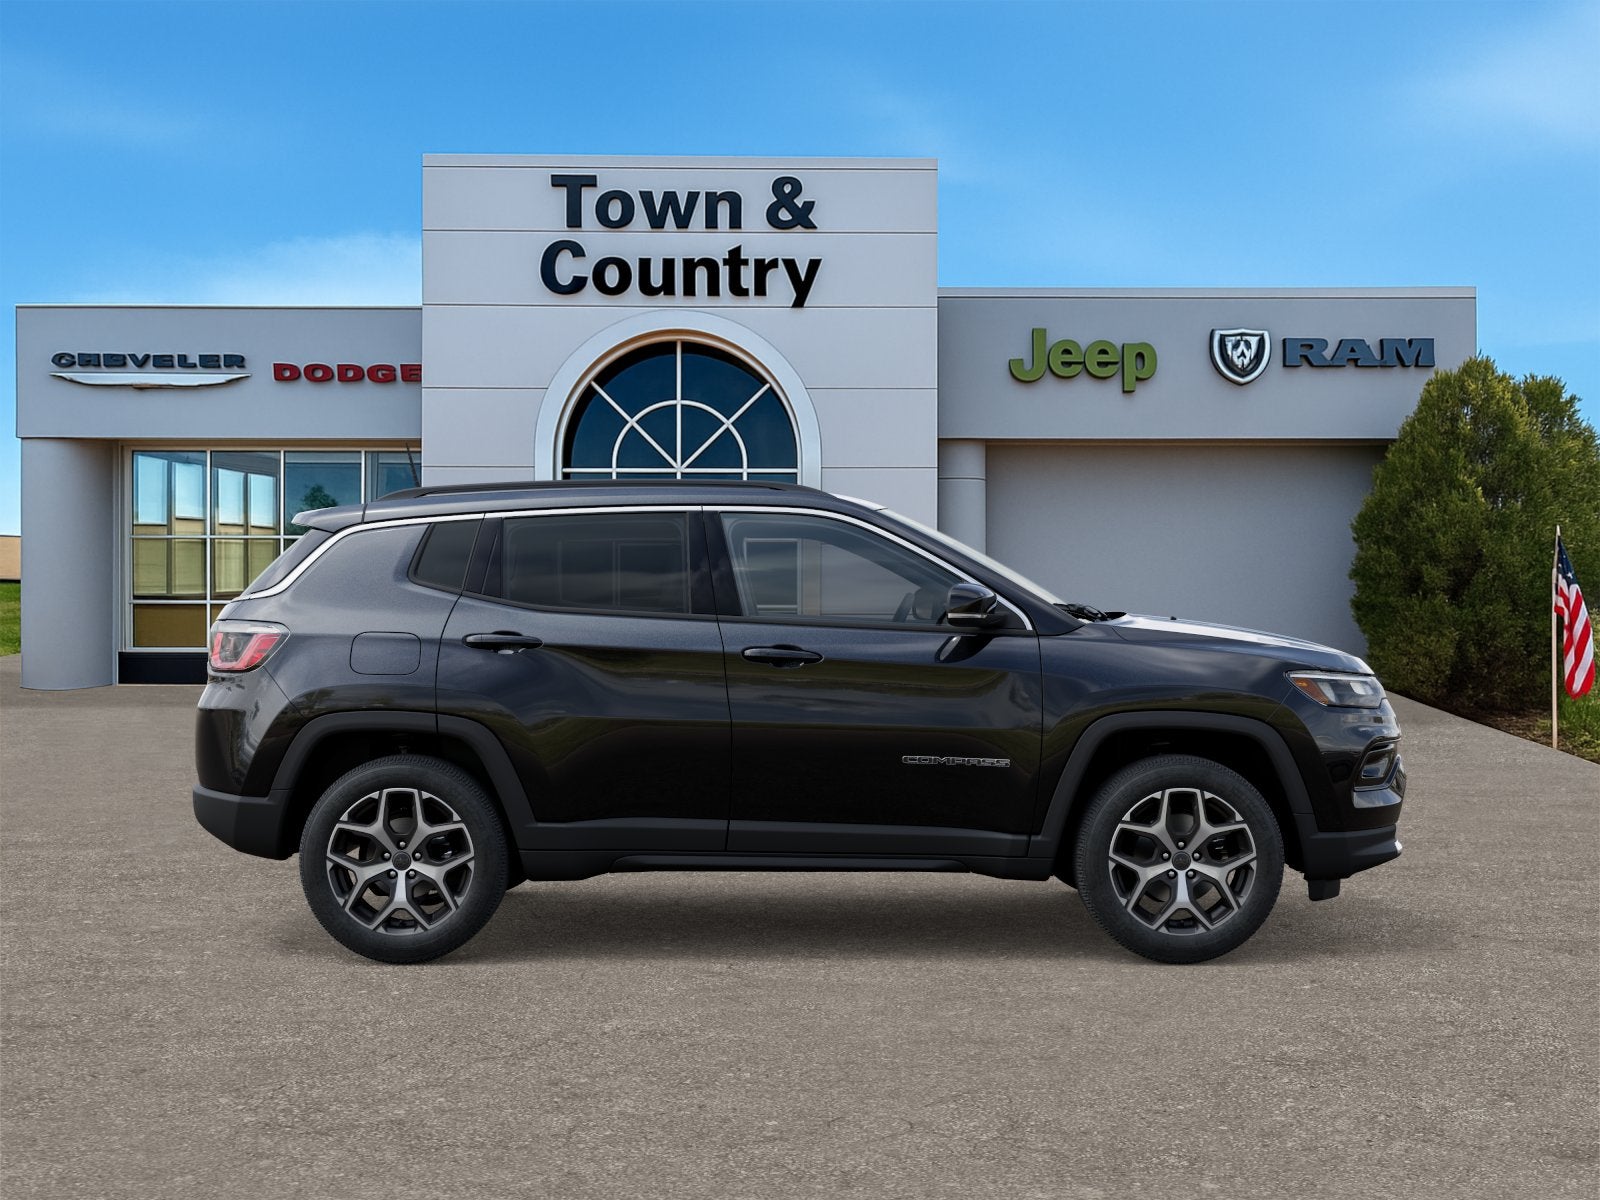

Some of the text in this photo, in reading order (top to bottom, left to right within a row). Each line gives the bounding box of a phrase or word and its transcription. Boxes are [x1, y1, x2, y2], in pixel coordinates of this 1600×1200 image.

[550, 174, 818, 230] Town &
[540, 239, 823, 308] Country
[272, 362, 422, 383] DODGE
[1009, 328, 1158, 393] Jeep
[1282, 337, 1436, 368] RAM
[901, 755, 1011, 768] COMPASS
